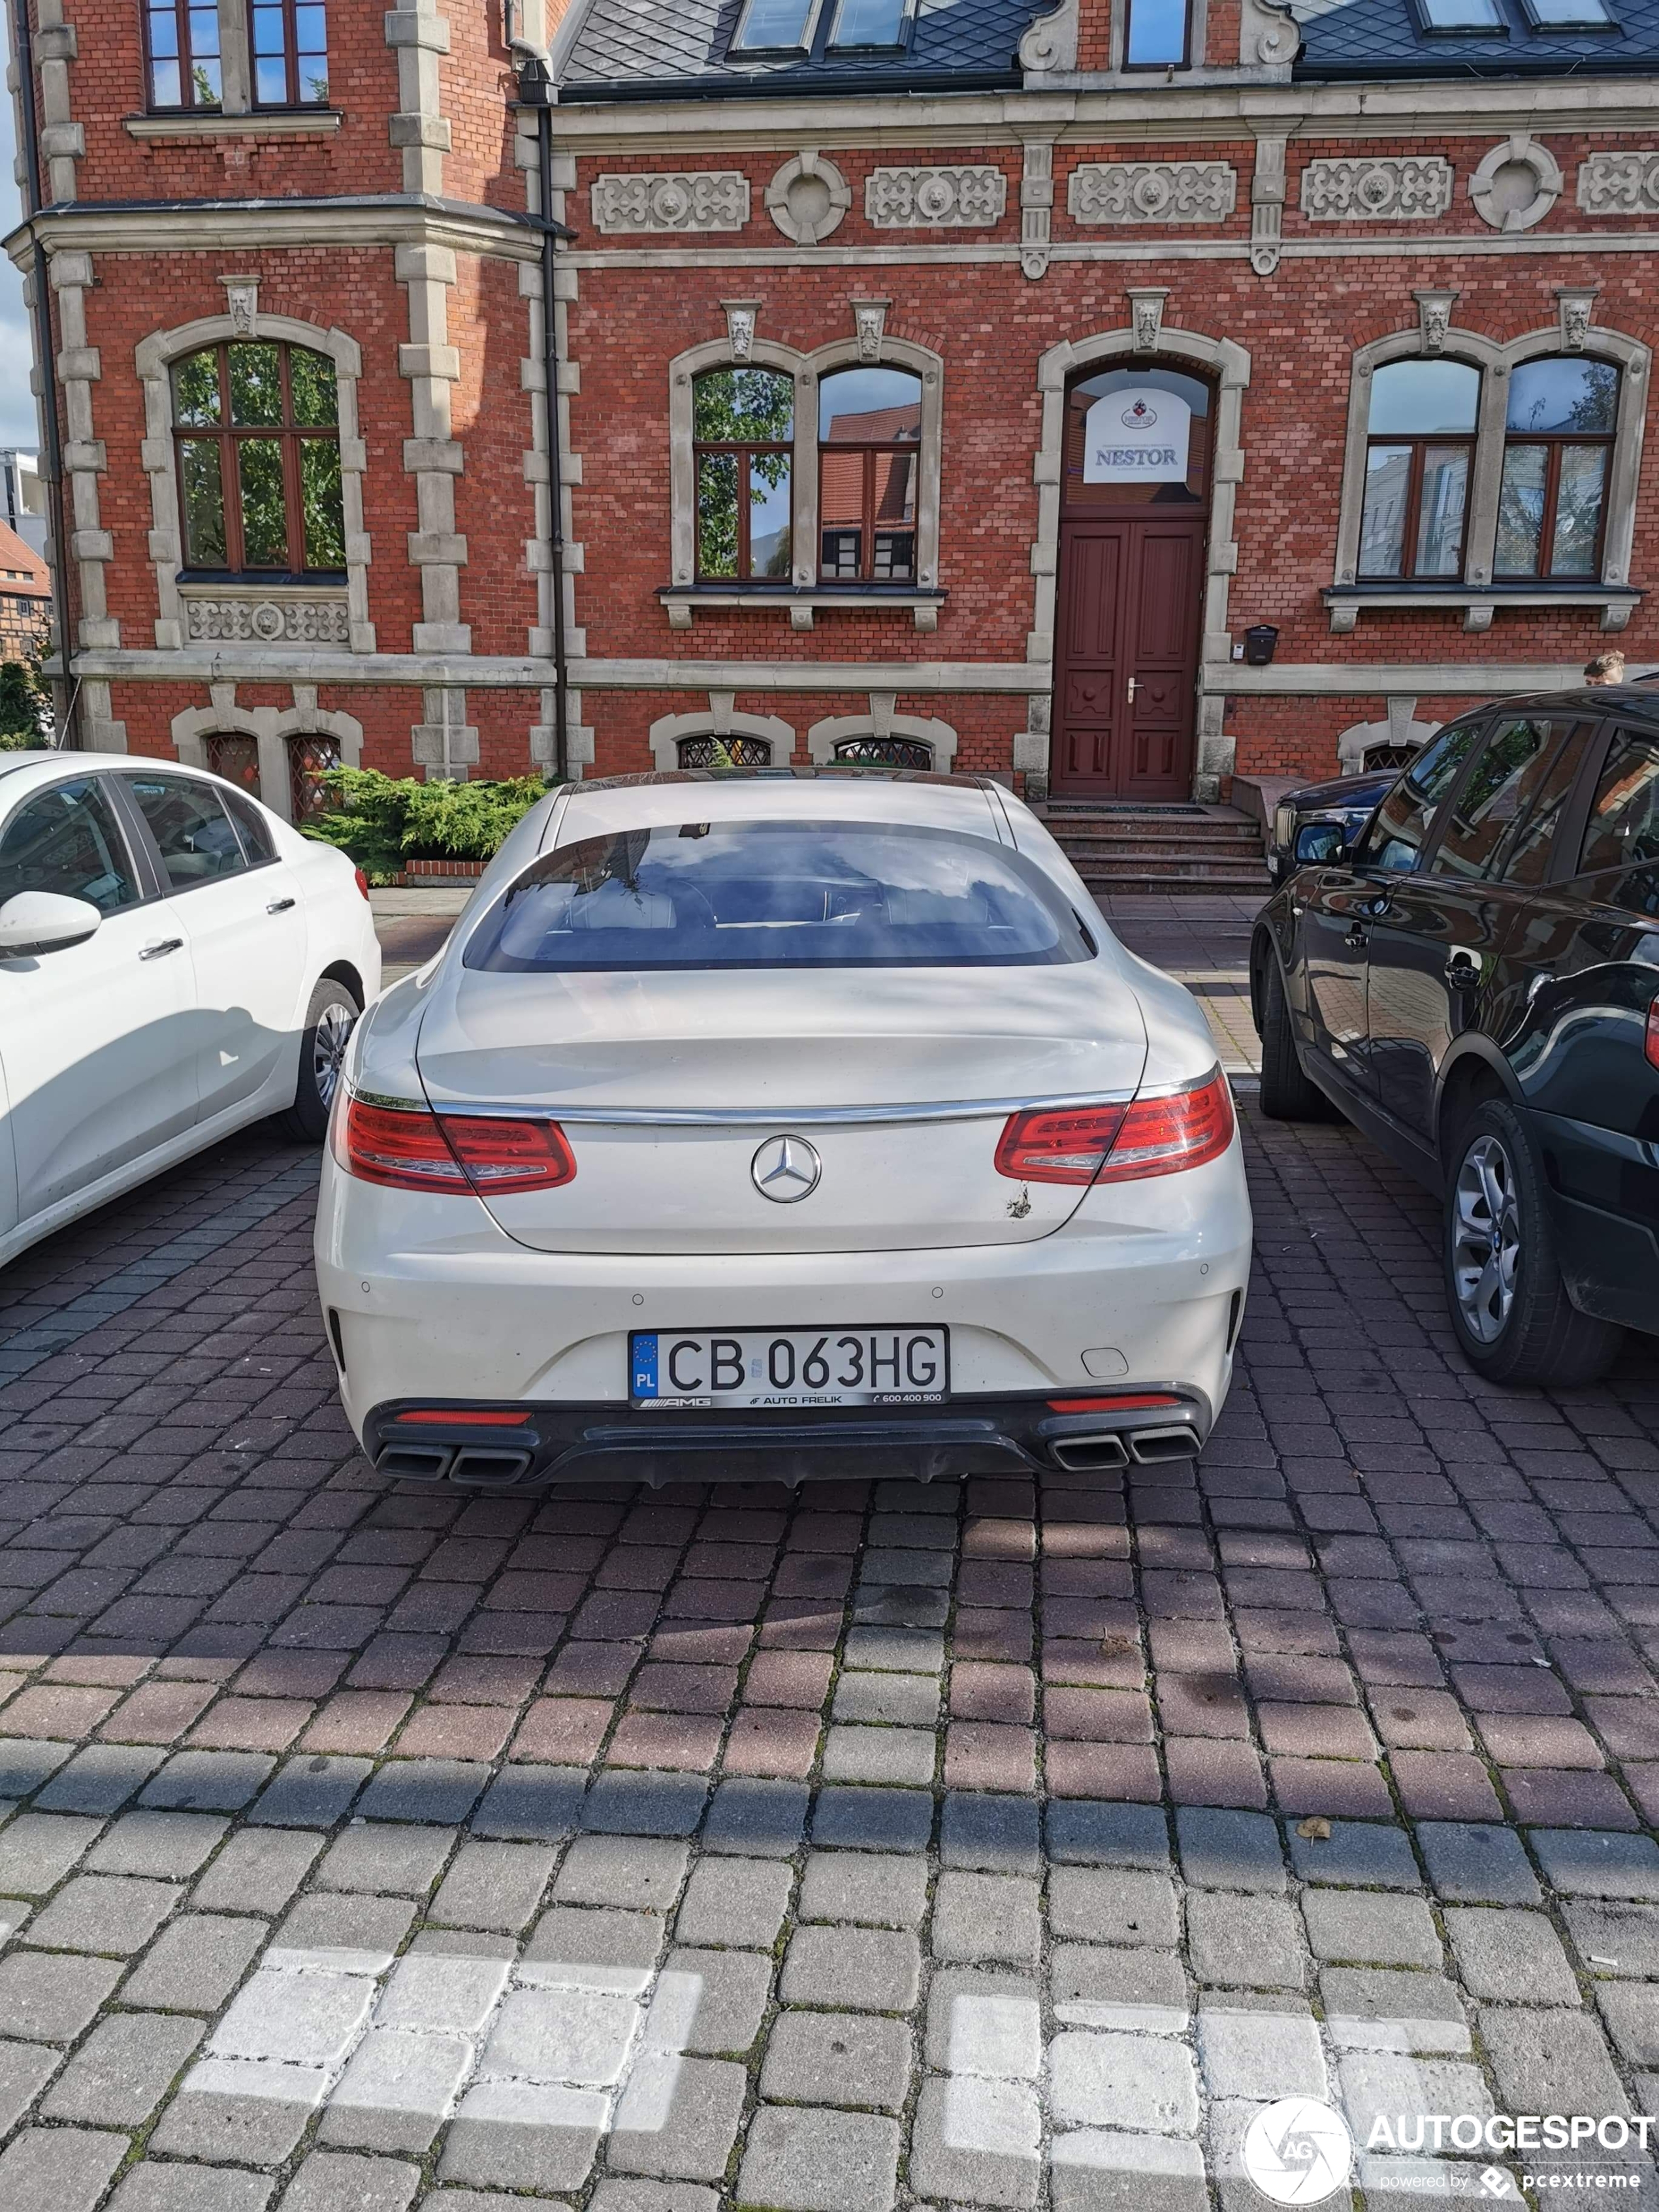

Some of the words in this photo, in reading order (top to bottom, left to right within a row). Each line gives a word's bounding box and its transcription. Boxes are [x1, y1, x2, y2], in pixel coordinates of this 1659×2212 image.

[1095, 449, 1178, 466] NESTOR
[669, 1339, 745, 1391] CB
[768, 1336, 937, 1389] 063HG
[636, 1374, 655, 1387] PL
